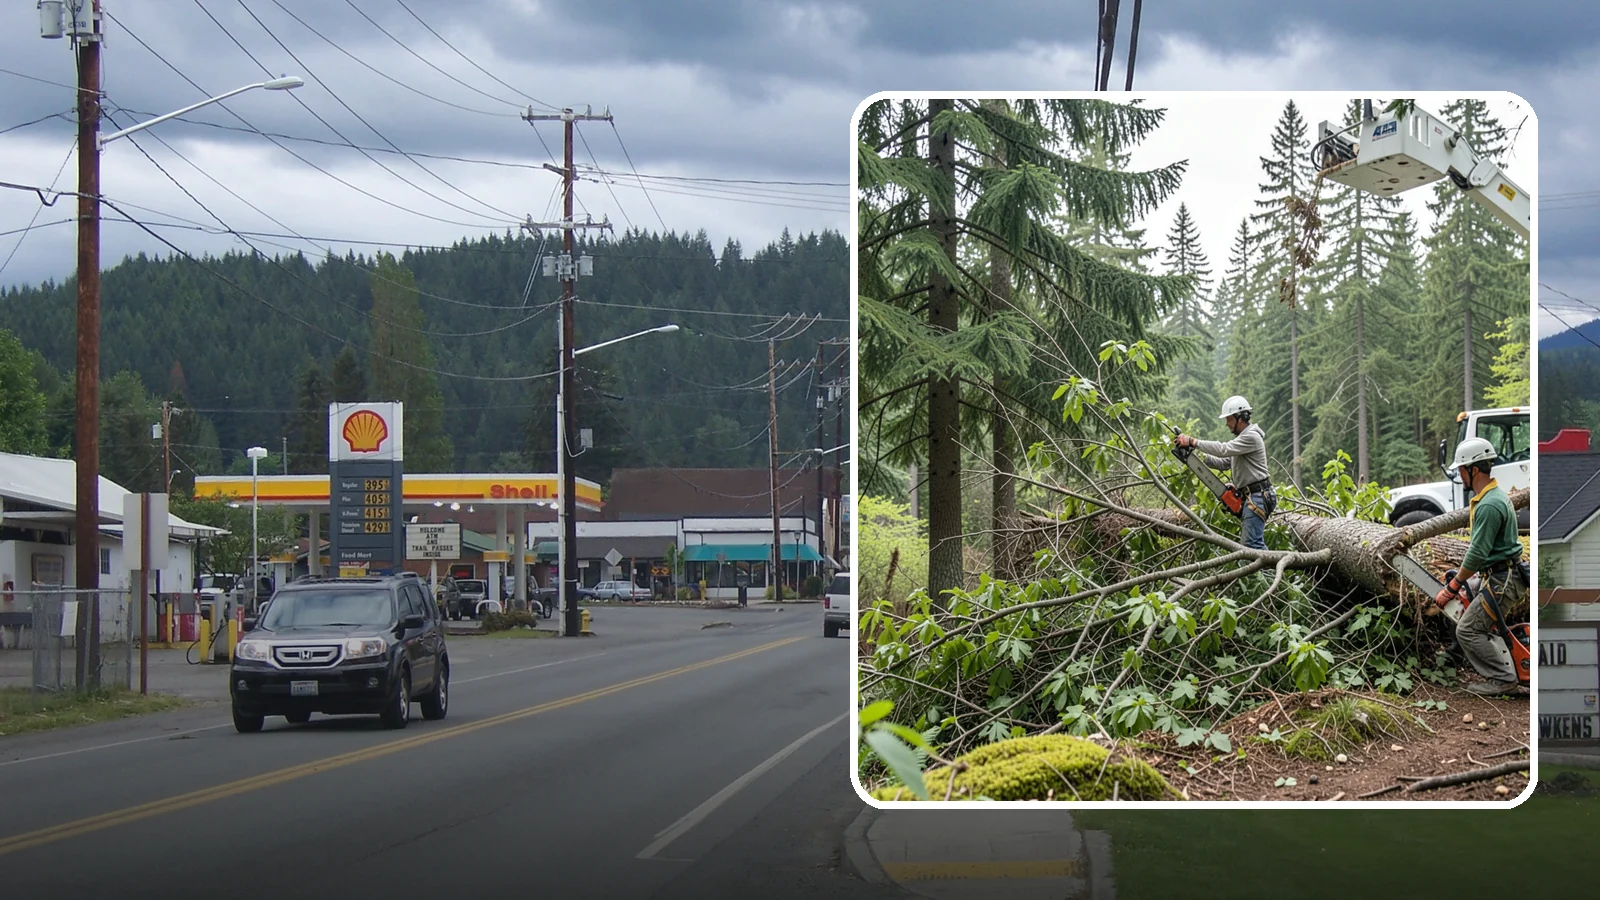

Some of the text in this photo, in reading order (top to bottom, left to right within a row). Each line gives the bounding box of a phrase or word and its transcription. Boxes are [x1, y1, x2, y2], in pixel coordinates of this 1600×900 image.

[366, 480, 383, 490] 395
[490, 484, 547, 499] Shell
[366, 494, 383, 504] 405
[366, 508, 383, 518] 415
[366, 522, 383, 532] 429
[1538, 642, 1567, 666] AID
